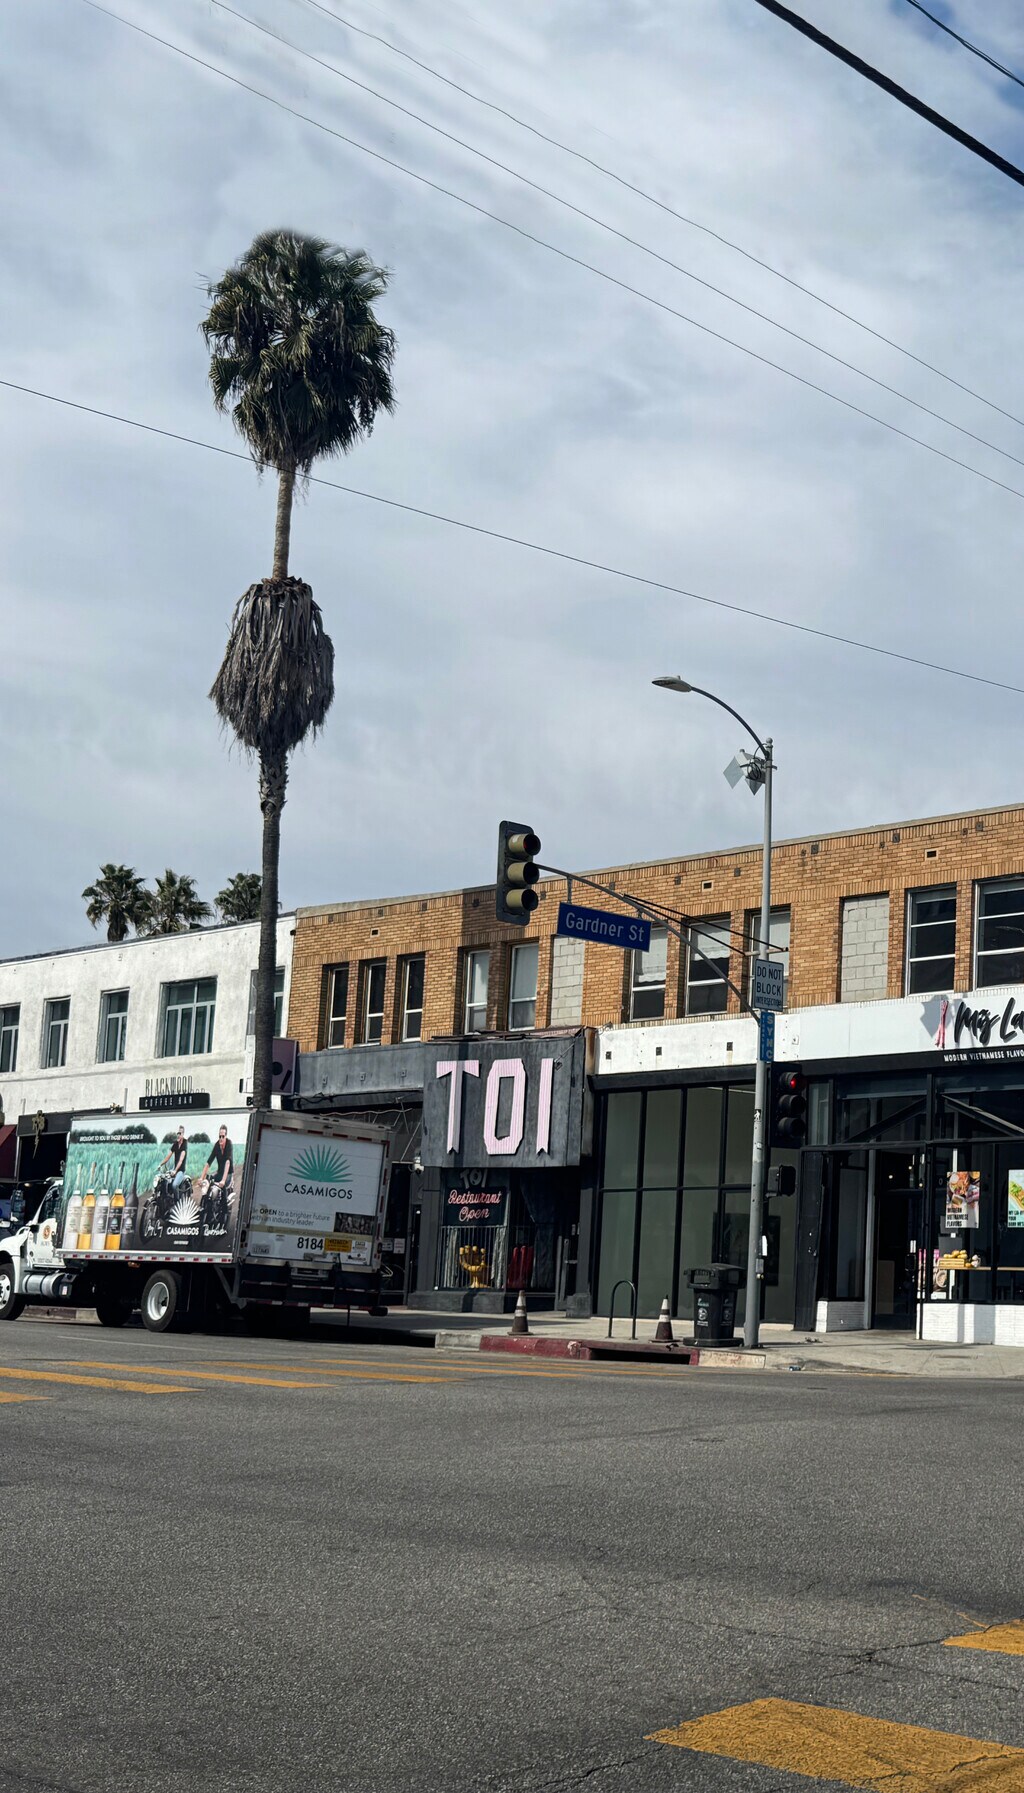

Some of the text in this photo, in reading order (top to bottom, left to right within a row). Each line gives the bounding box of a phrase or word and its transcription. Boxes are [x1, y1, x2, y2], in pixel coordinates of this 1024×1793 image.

[565, 911, 645, 942] Gardner St
[757, 966, 782, 981] DO NOT
[756, 981, 782, 996] BLOCK
[766, 1015, 774, 1060] SYNC
[943, 1054, 968, 1062] MODERN
[969, 1050, 1005, 1061] VIETNAMESE
[145, 1075, 193, 1097] BLACKWOOD
[144, 1097, 173, 1108] COFFEE
[436, 1057, 554, 1155] TOI
[284, 1183, 353, 1200] CASAMIGOS
[448, 1189, 502, 1205] Restaurant
[259, 1208, 277, 1216] OPEN
[458, 1206, 490, 1222] Open
[166, 1226, 200, 1236] CASAMIGOS
[297, 1236, 324, 1251] 8184
